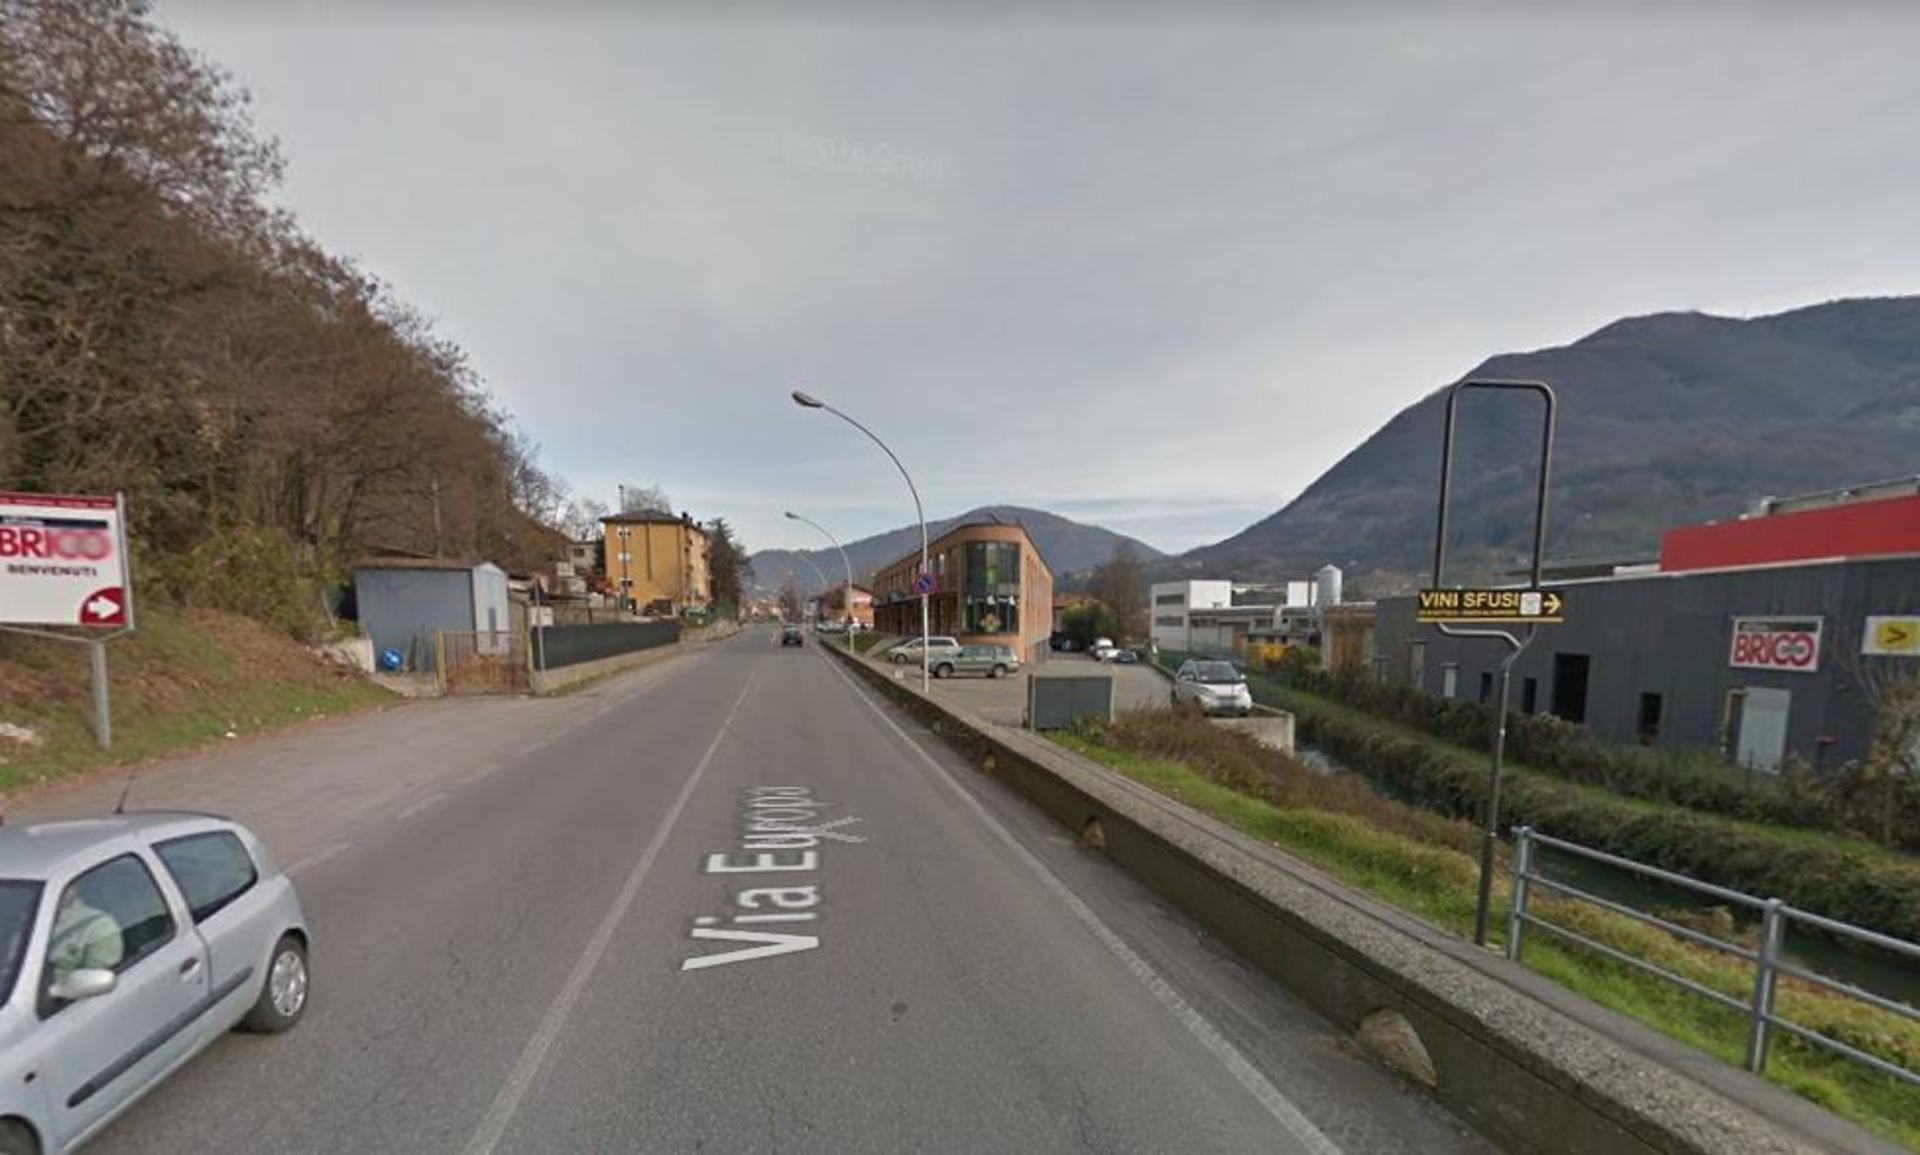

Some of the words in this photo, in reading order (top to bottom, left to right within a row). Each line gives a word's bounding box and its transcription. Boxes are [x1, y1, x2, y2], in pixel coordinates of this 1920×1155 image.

[0, 528, 112, 560] BRICO
[8, 565, 97, 576] BENVENUTI
[1421, 592, 1458, 607] VINI
[1463, 592, 1519, 607] SFUSI
[1734, 633, 1814, 666] BRICO
